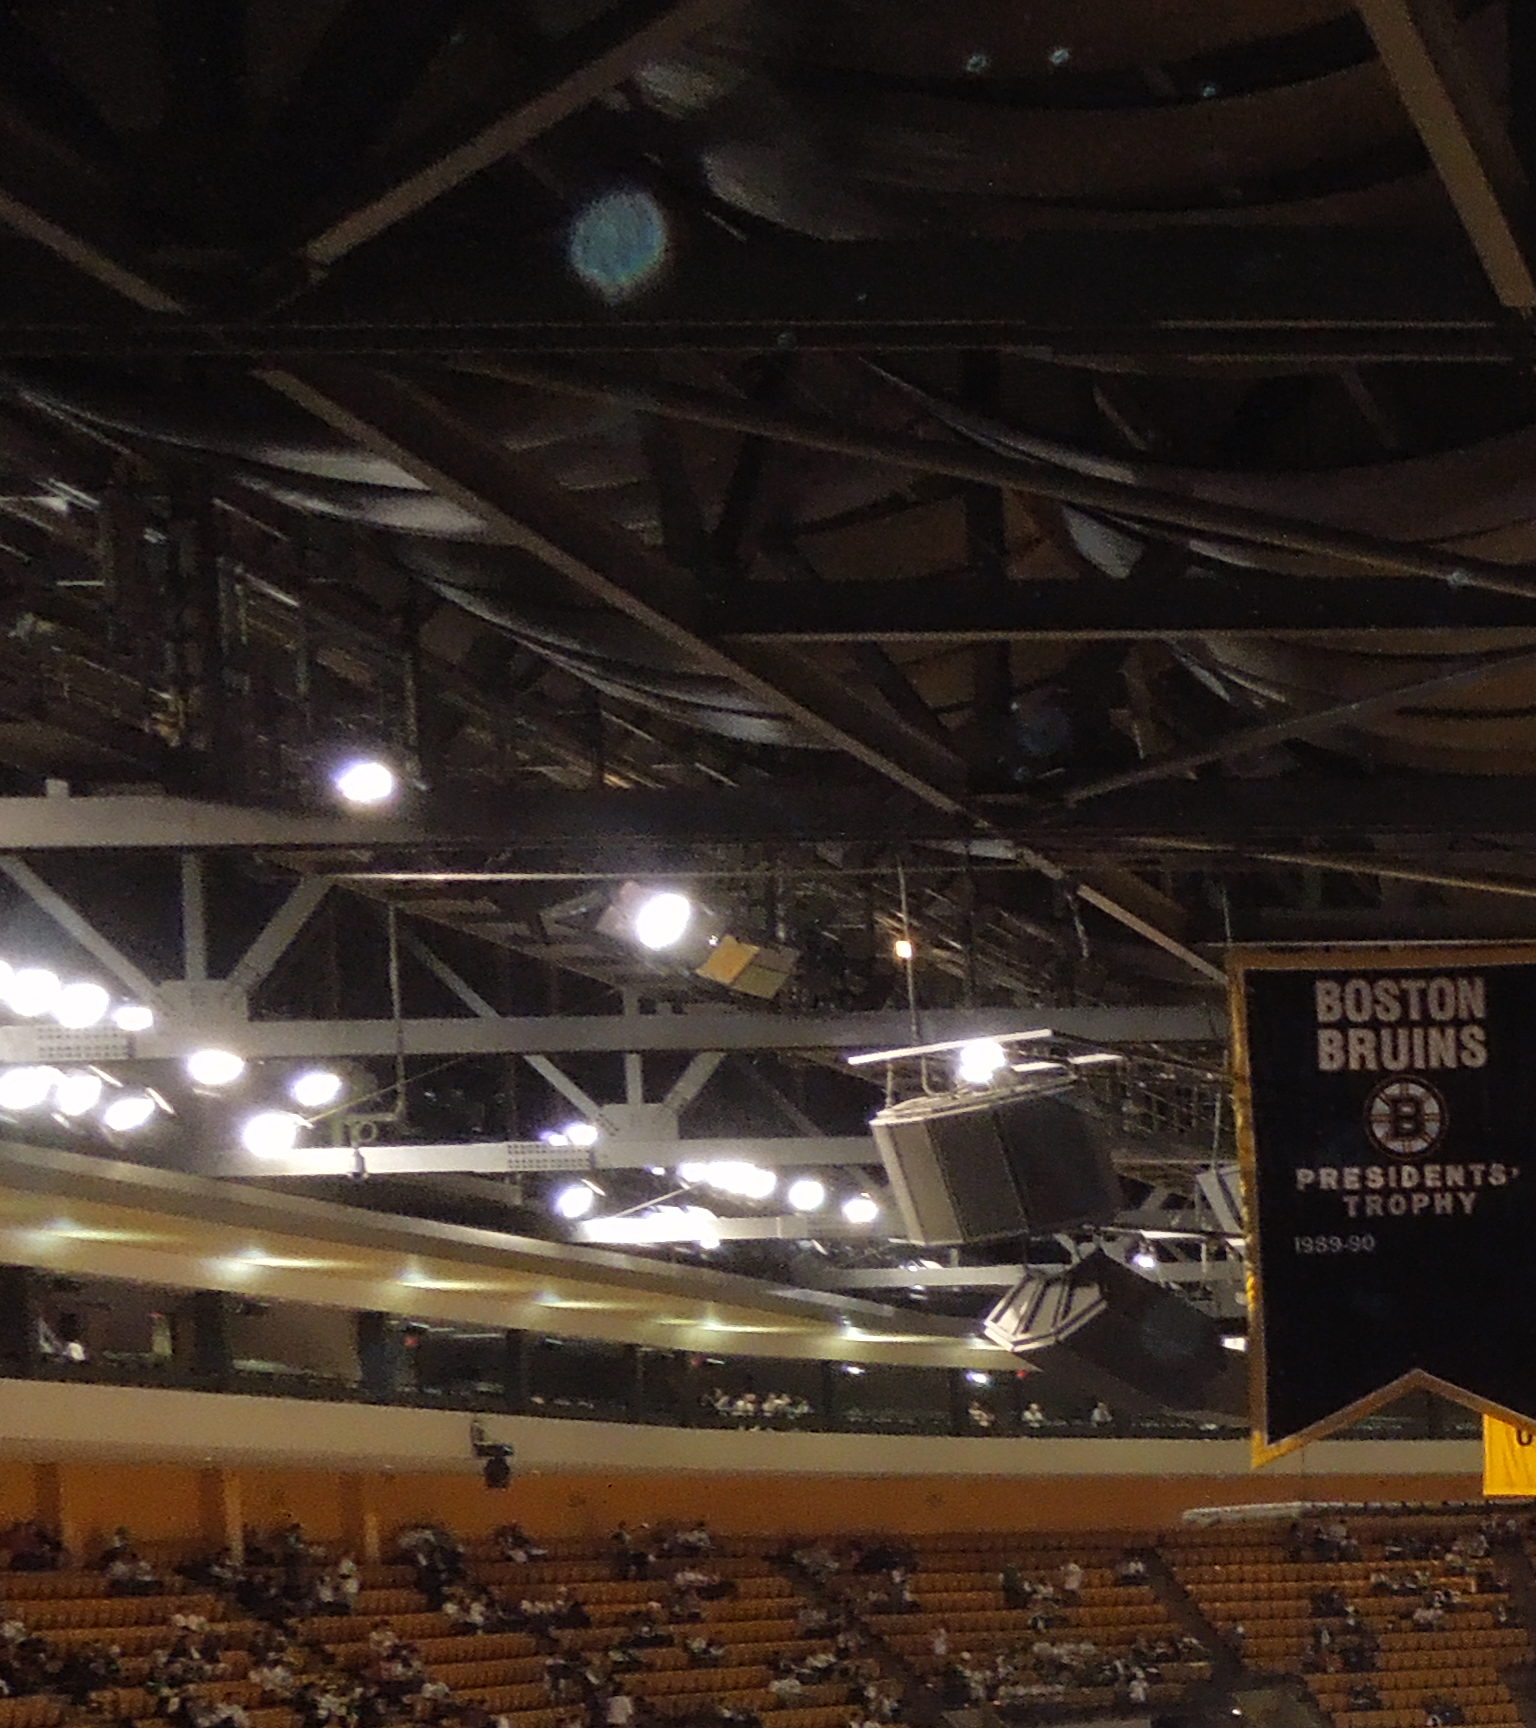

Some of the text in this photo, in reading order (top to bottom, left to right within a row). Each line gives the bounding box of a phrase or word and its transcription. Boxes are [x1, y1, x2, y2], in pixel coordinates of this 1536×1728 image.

[1315, 976, 1487, 1022] BOSTON
[1317, 1024, 1489, 1071] BRUINS
[1342, 1191, 1478, 1217] TROPHY
